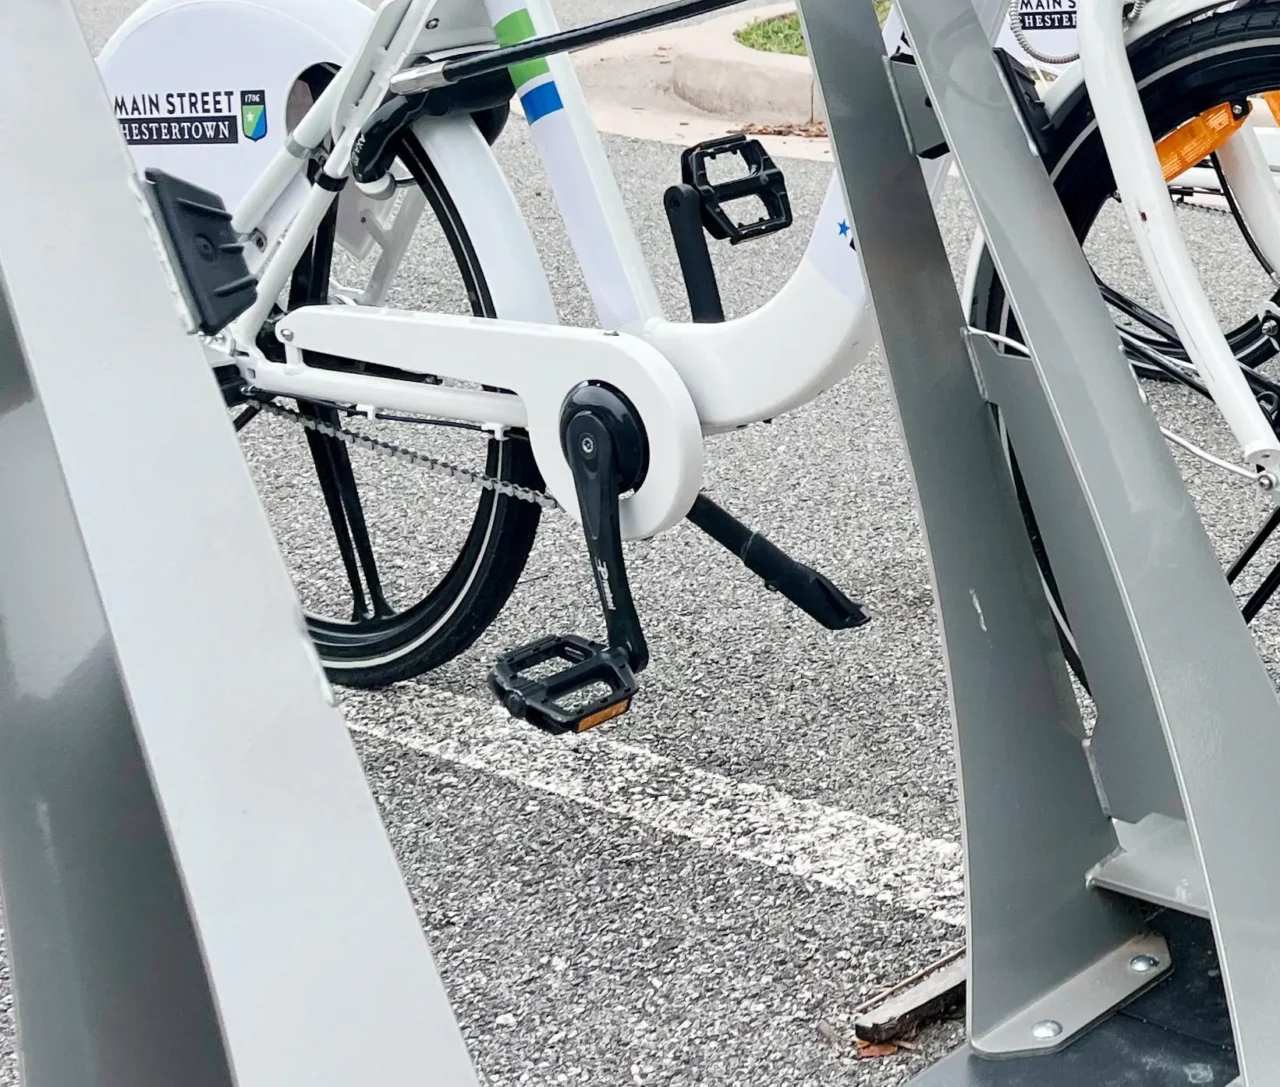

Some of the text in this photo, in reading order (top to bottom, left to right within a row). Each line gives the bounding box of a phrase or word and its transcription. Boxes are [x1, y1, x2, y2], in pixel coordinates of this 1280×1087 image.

[114, 91, 234, 116] MAIN STREET
[244, 93, 260, 103] 1706
[120, 121, 230, 141] HESTERTOWN
